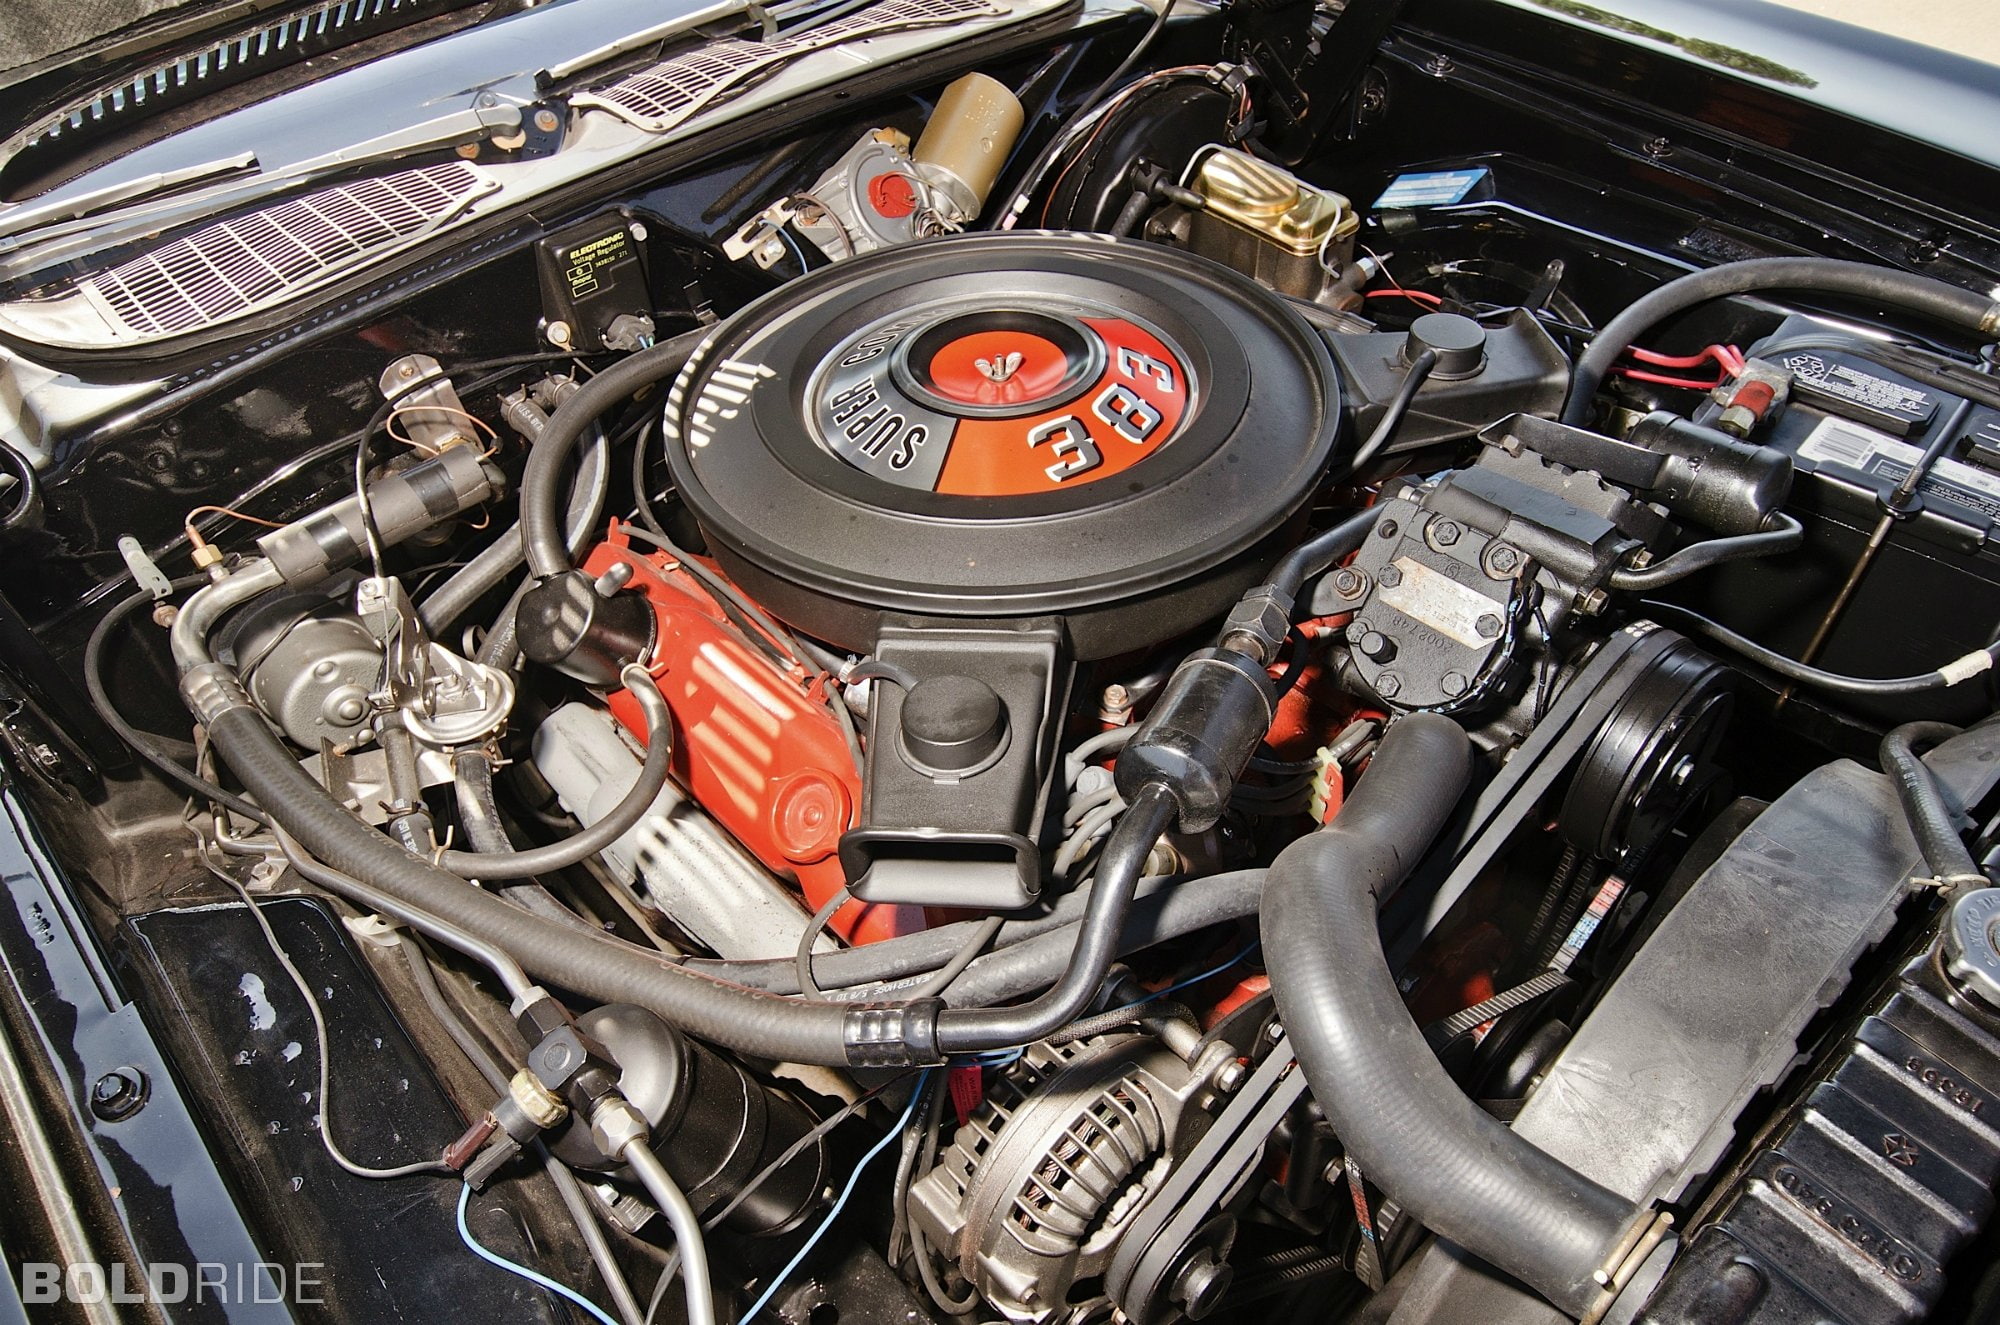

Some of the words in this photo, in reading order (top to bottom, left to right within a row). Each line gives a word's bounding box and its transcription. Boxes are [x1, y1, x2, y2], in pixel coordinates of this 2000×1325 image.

[570, 231, 624, 259] ELECTRONIC
[572, 253, 596, 266] Voltage
[596, 240, 625, 257] Regulator
[830, 374, 928, 472] SUPER
[1027, 346, 1175, 483] 383
